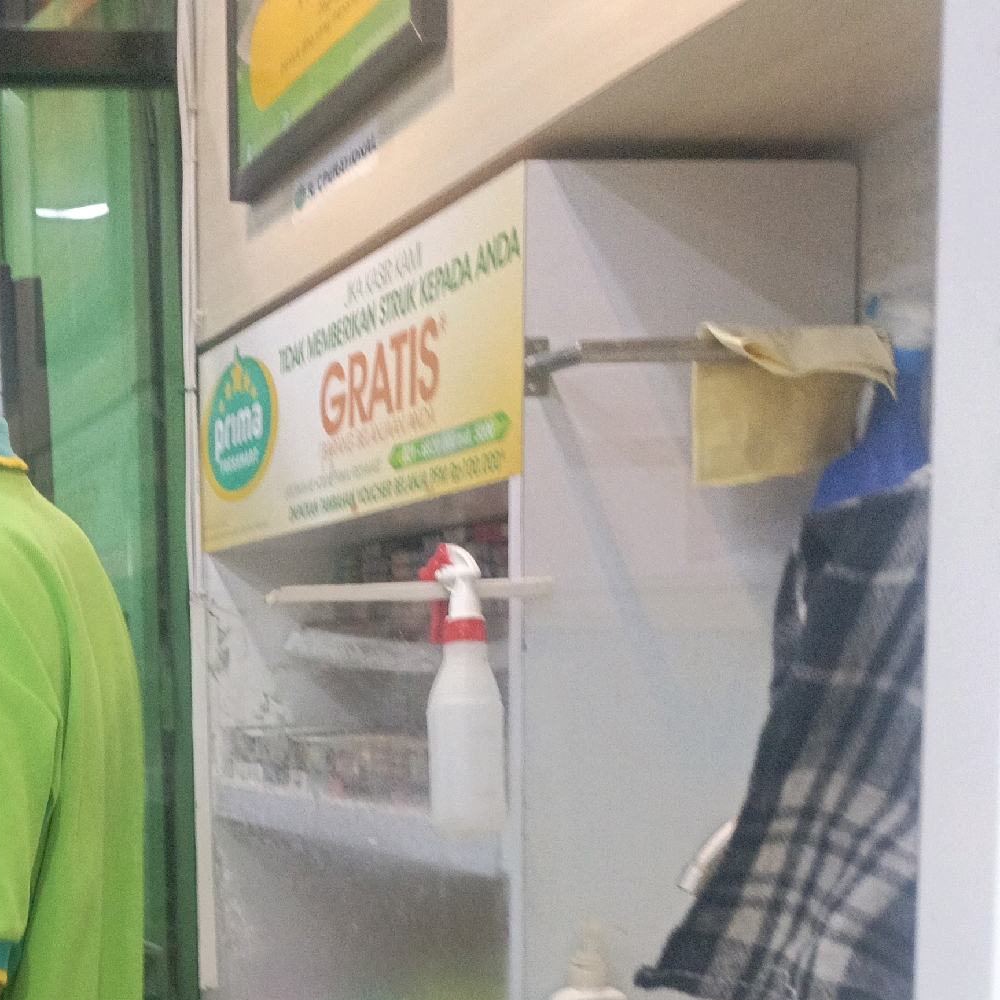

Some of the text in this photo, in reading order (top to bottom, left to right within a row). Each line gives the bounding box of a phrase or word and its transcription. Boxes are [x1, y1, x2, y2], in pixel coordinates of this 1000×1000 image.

[277, 335, 307, 375] TIDAK
[379, 287, 417, 328] STRUK
[417, 252, 473, 307] KEPADA
[474, 225, 521, 279] ANDA
[214, 401, 264, 464] prima
